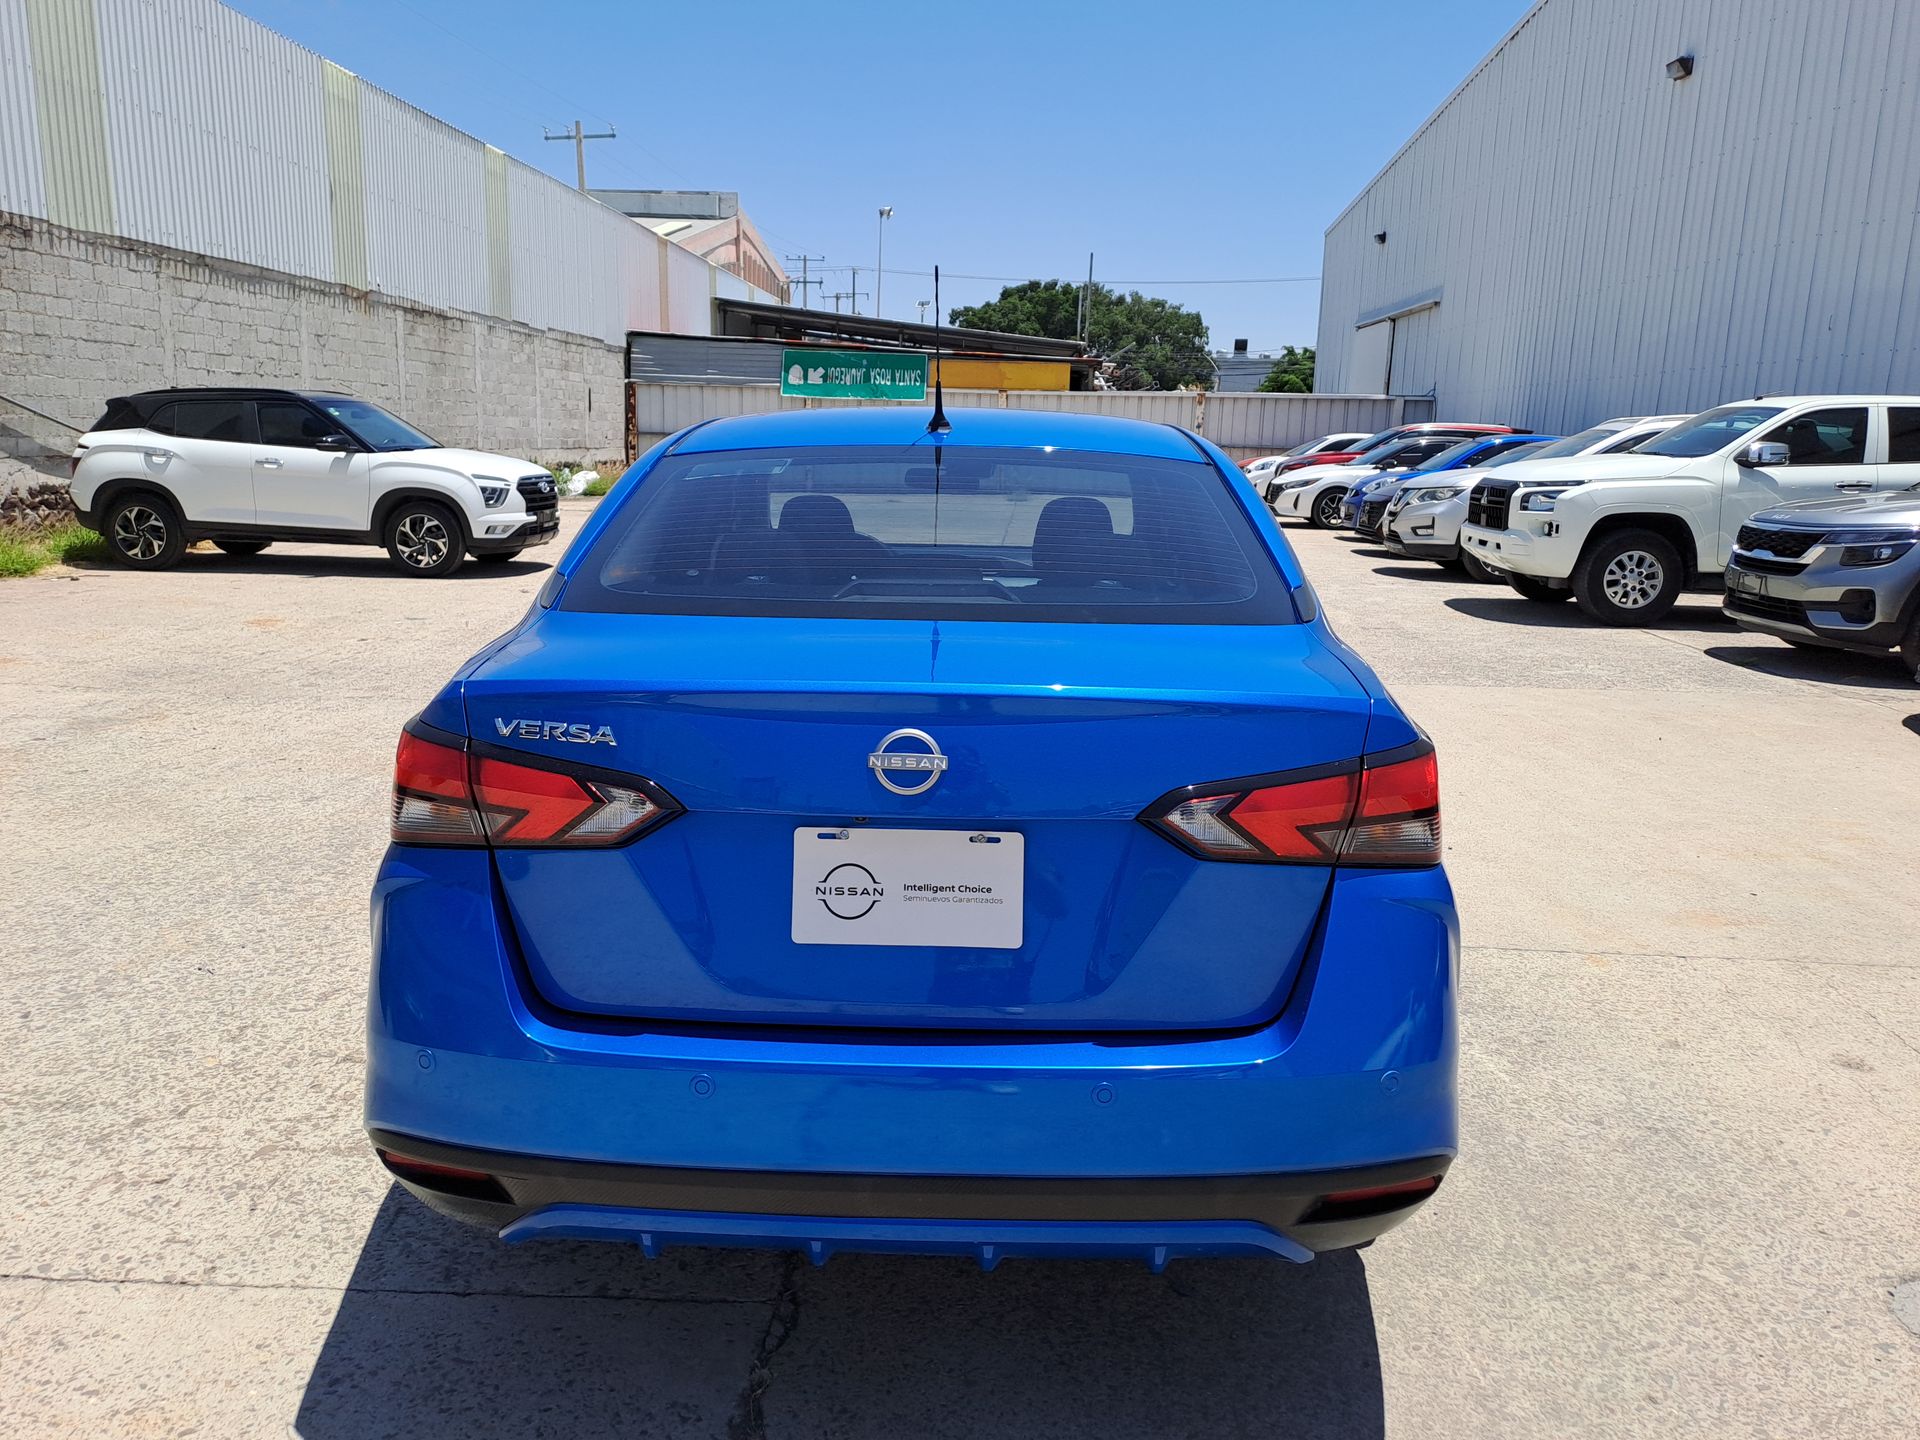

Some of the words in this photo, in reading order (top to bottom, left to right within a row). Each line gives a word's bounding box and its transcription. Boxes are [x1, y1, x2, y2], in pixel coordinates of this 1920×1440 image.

[827, 367, 866, 384] JAUREGUI
[870, 368, 892, 385] ROSA
[895, 369, 921, 386] SANTA
[494, 717, 617, 746] VERSA
[869, 755, 946, 769] NISSAN
[815, 886, 884, 896] NISSAN
[903, 883, 956, 894] Intelligent
[958, 884, 993, 894] Choice
[903, 894, 951, 903] Seminuevos
[952, 895, 1004, 905] Garantizados
